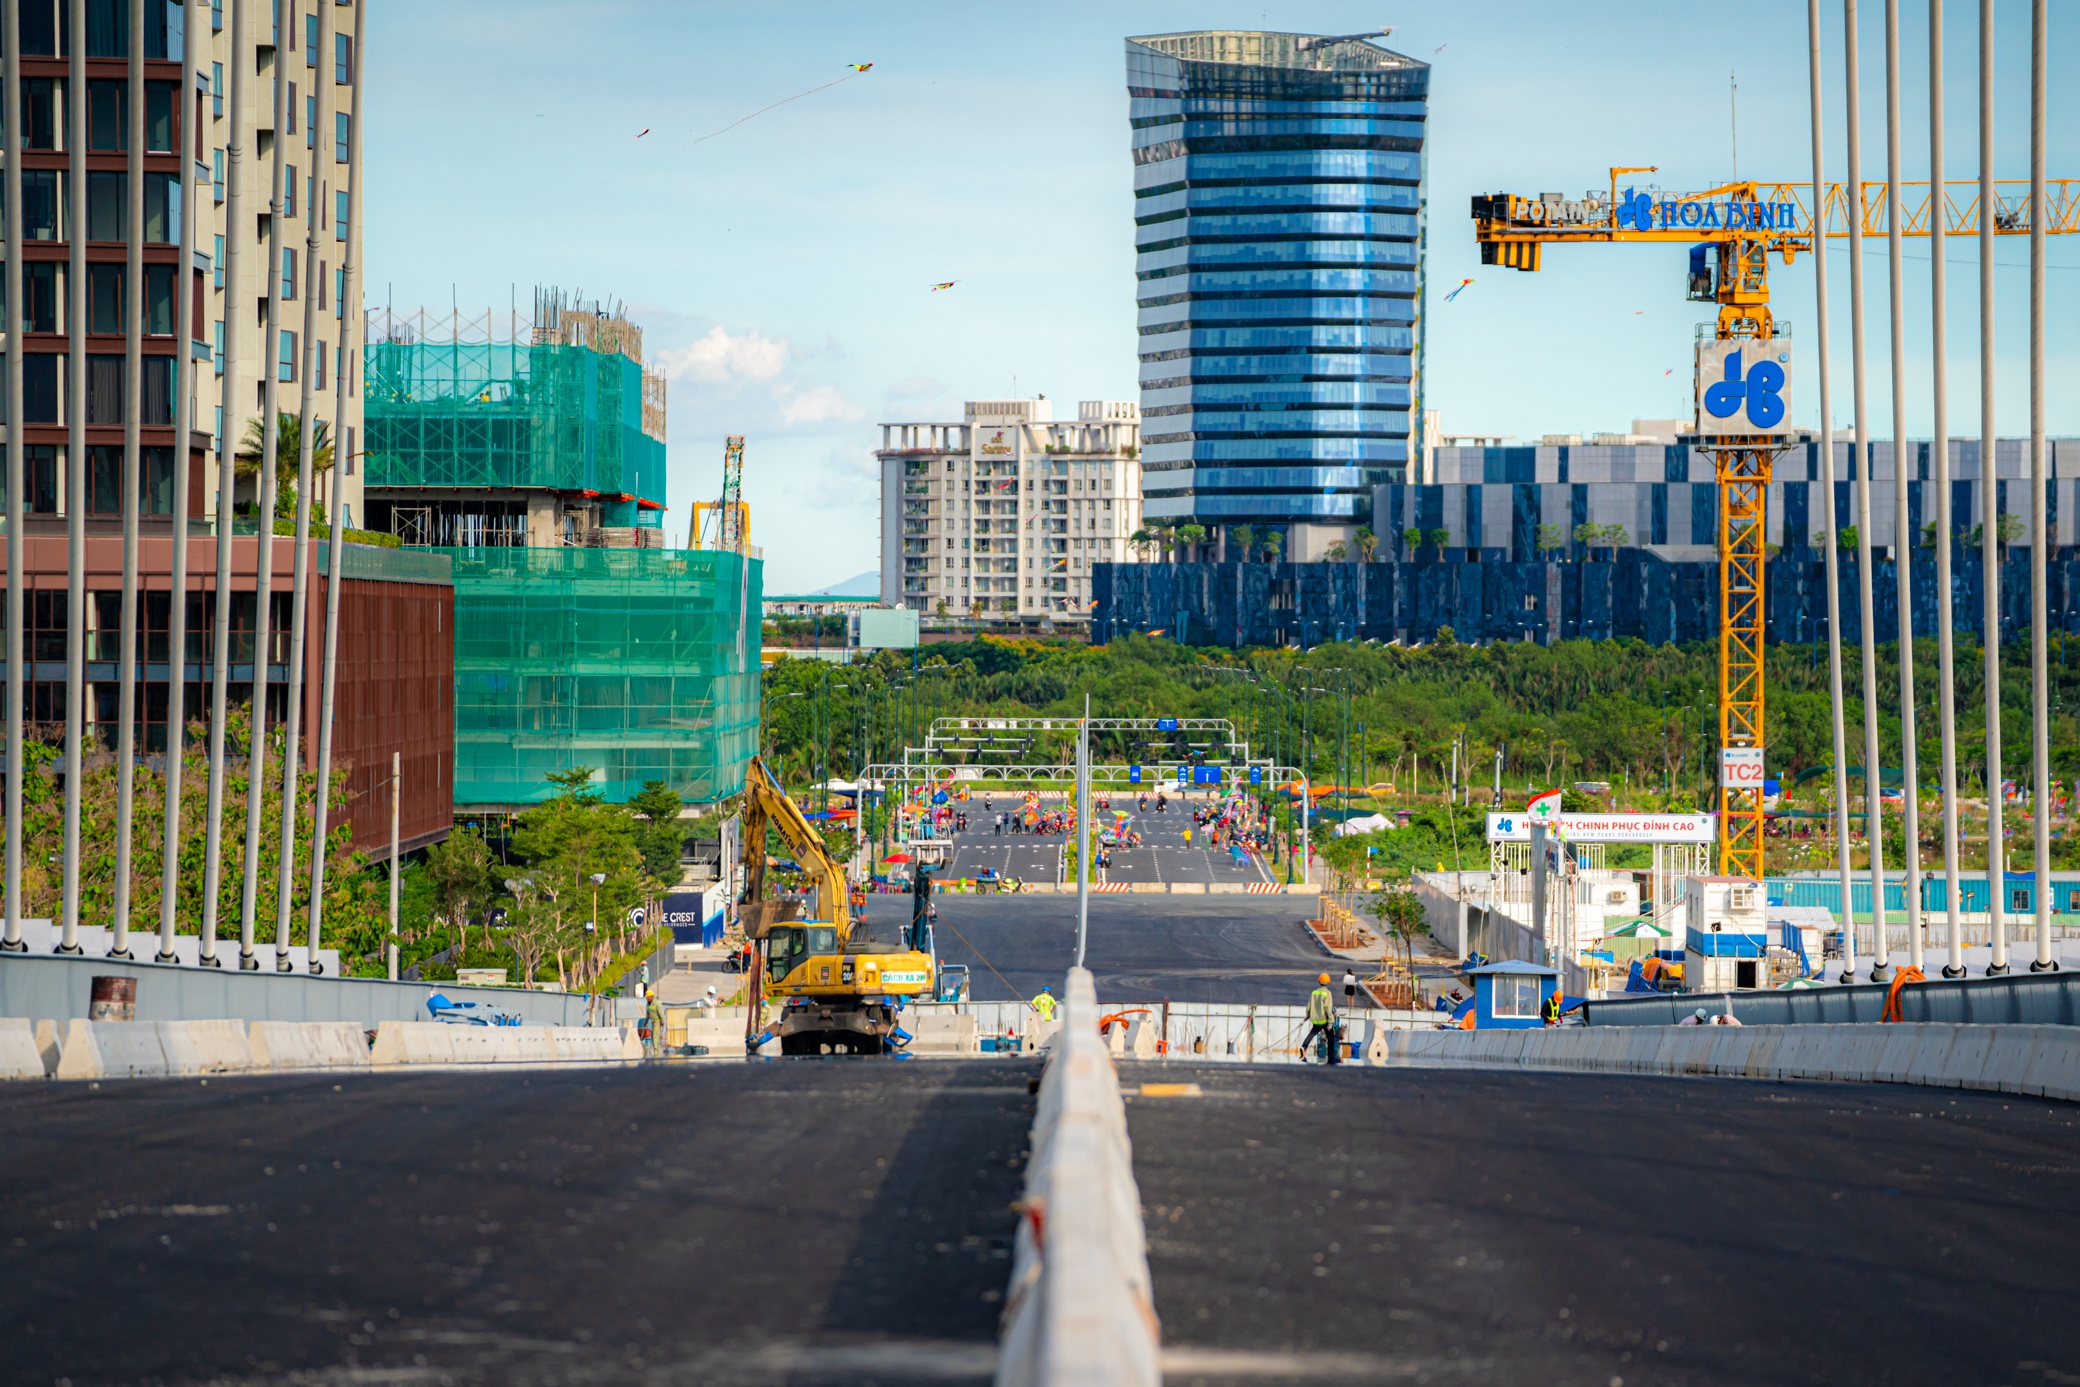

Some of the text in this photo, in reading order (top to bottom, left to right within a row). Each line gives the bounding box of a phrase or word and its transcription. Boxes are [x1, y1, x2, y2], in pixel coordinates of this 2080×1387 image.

[1515, 202, 1590, 221] POTAIN
[1724, 763, 1763, 780] TC2
[770, 813, 795, 850] KOMATSU
[1576, 821, 1609, 830] CHINH
[1612, 821, 1640, 832] PHỤC
[1672, 822, 1695, 831] CAO
[670, 912, 696, 922] CREST
